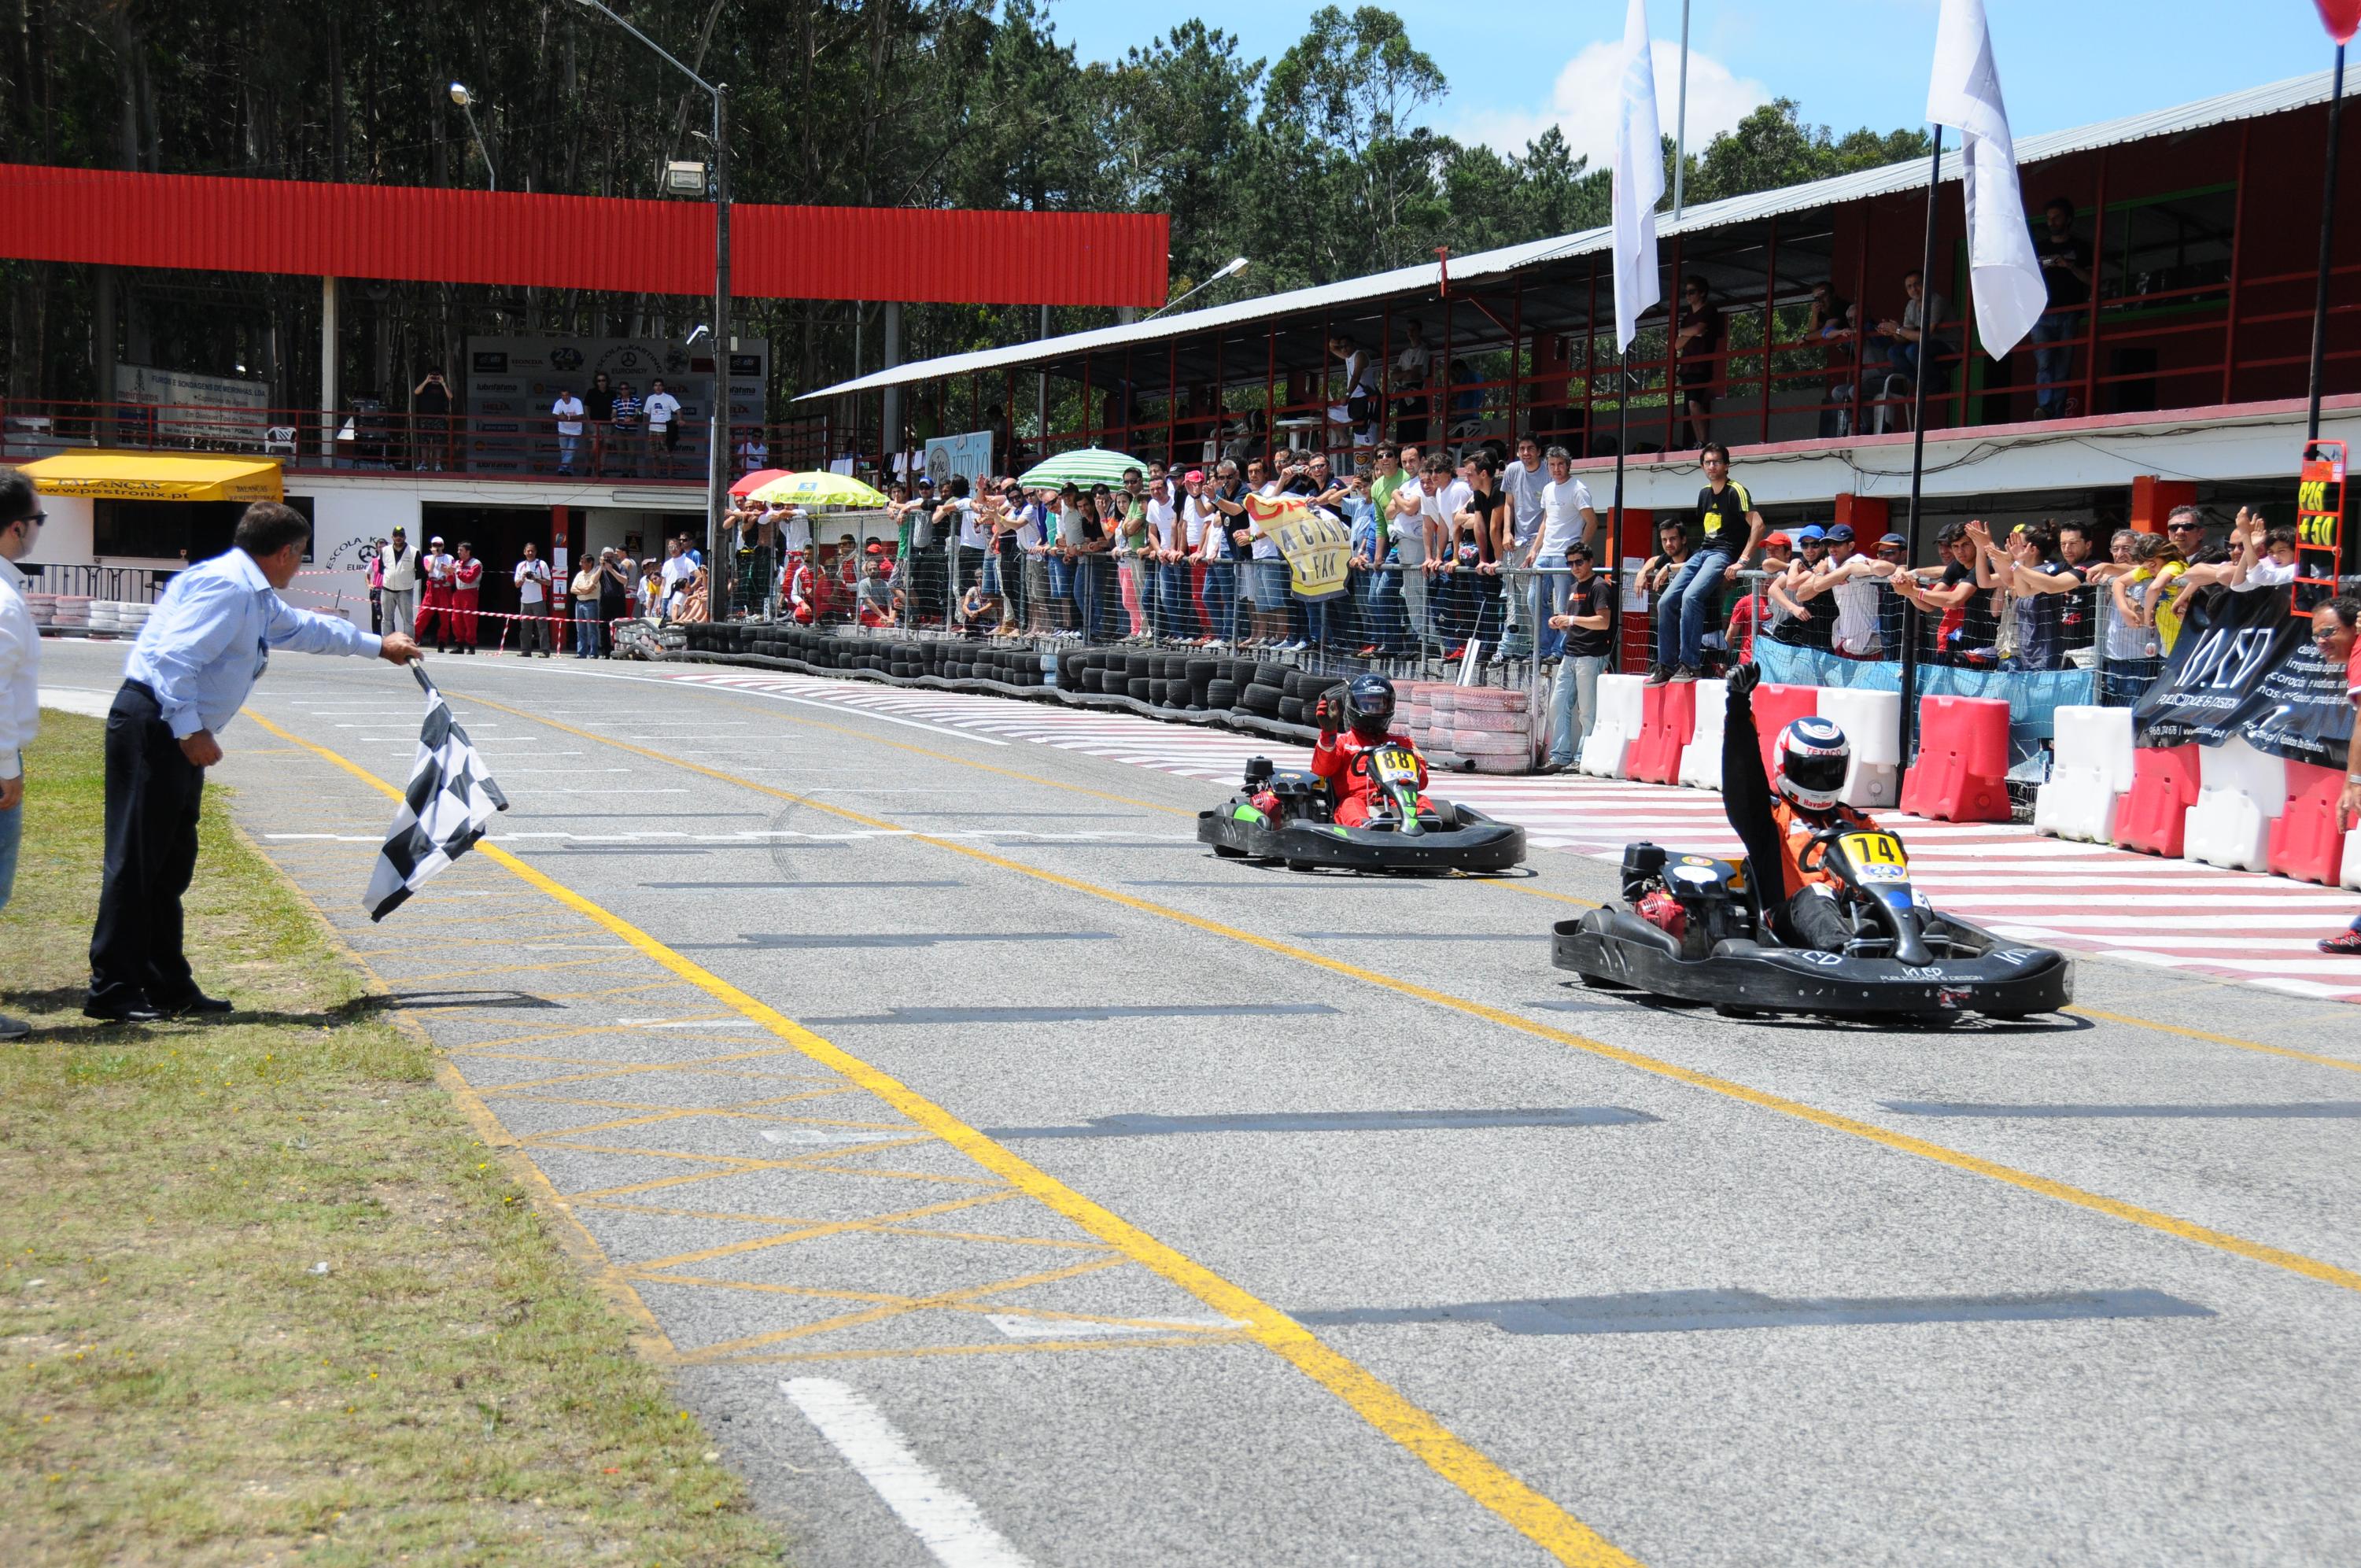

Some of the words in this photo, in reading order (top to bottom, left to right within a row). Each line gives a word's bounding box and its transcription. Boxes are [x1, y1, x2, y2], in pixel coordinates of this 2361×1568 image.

[58, 478, 161, 491] BALANÇAS
[2298, 481, 2326, 511] P26
[326, 537, 362, 570] ESCOLA
[1382, 751, 1410, 769] 88
[1806, 747, 1842, 756] TEXACO
[1803, 799, 1832, 809] Havoline
[1852, 836, 1895, 863] 74
